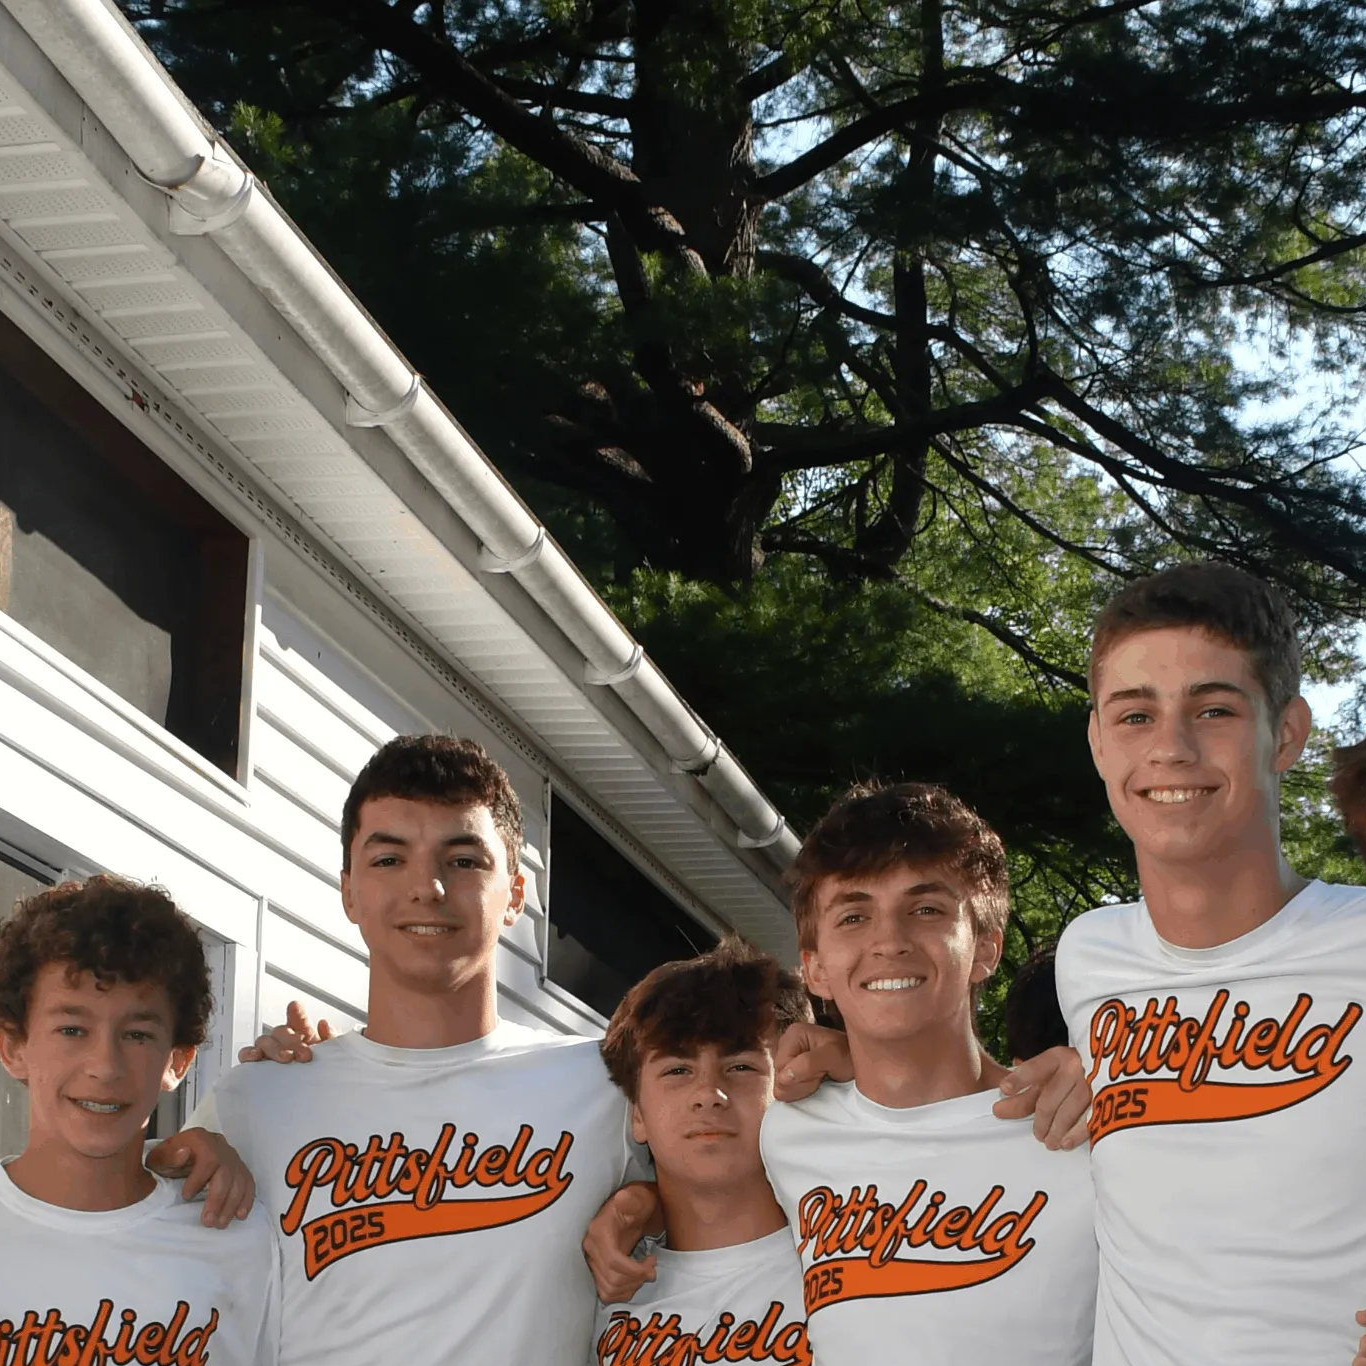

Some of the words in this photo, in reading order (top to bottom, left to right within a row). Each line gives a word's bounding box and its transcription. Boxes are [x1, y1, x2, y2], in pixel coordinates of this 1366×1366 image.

[1087, 989, 1363, 1092] Pittsfield
[1090, 1088, 1148, 1138] 2025
[280, 1123, 574, 1236] Pittsfield
[798, 1179, 1048, 1268] Pittsfield
[313, 1211, 385, 1264] 2025
